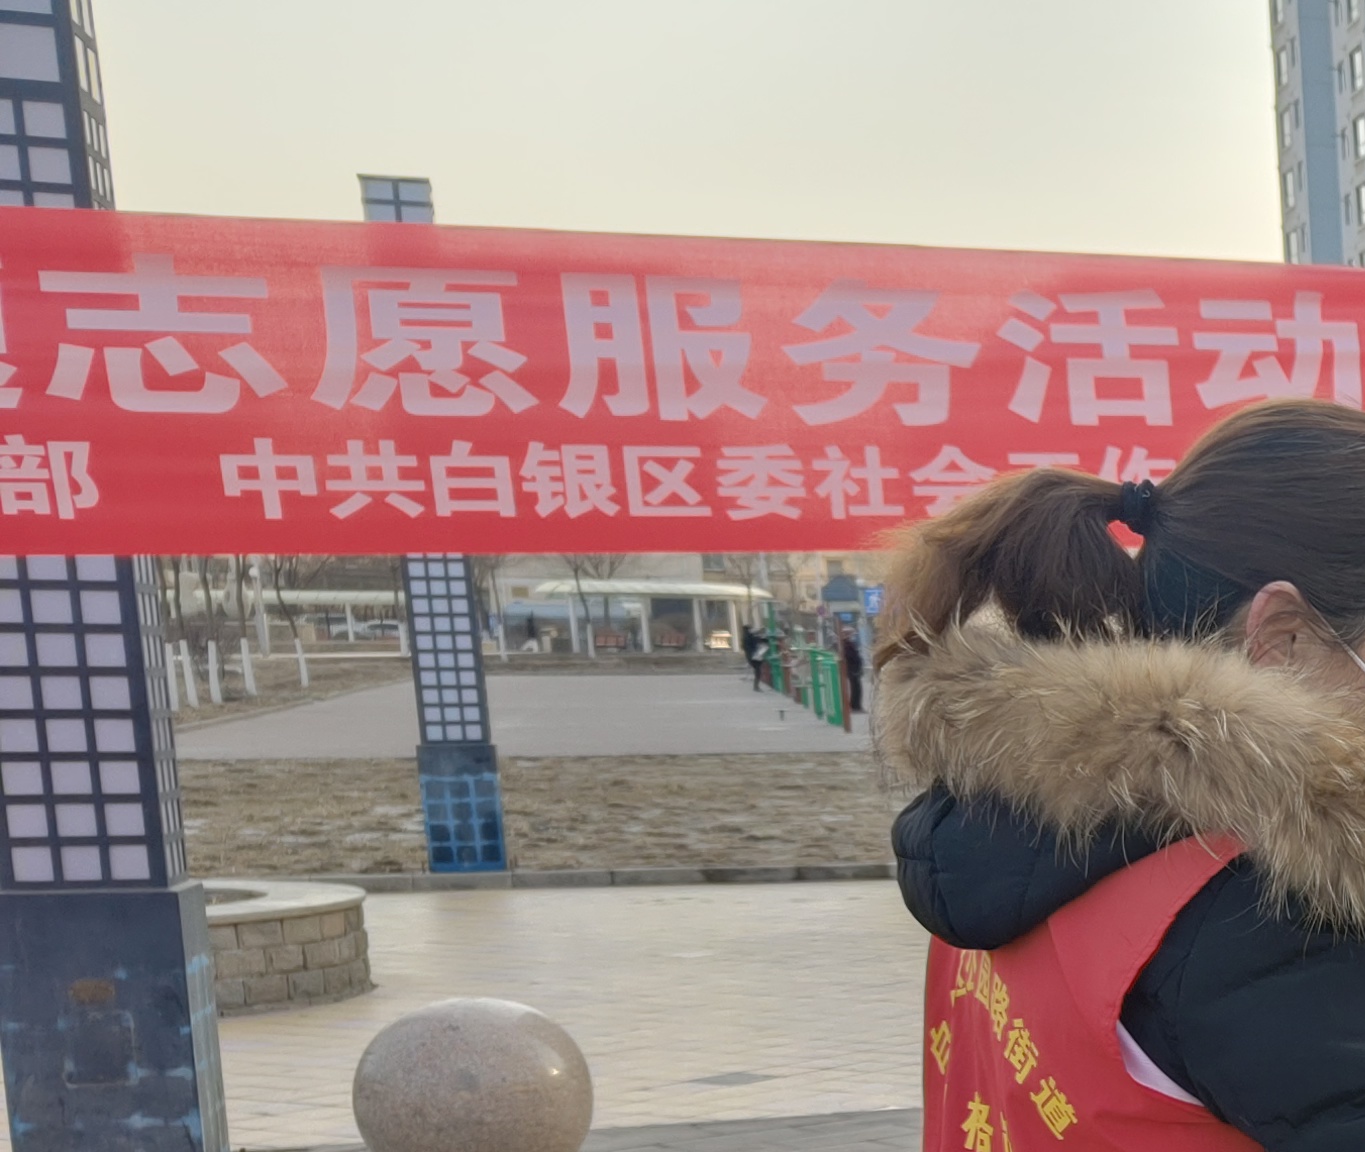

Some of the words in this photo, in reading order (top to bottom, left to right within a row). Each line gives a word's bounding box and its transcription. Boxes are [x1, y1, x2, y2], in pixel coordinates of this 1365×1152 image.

[0, 252, 1362, 426] 志愿服务活动
